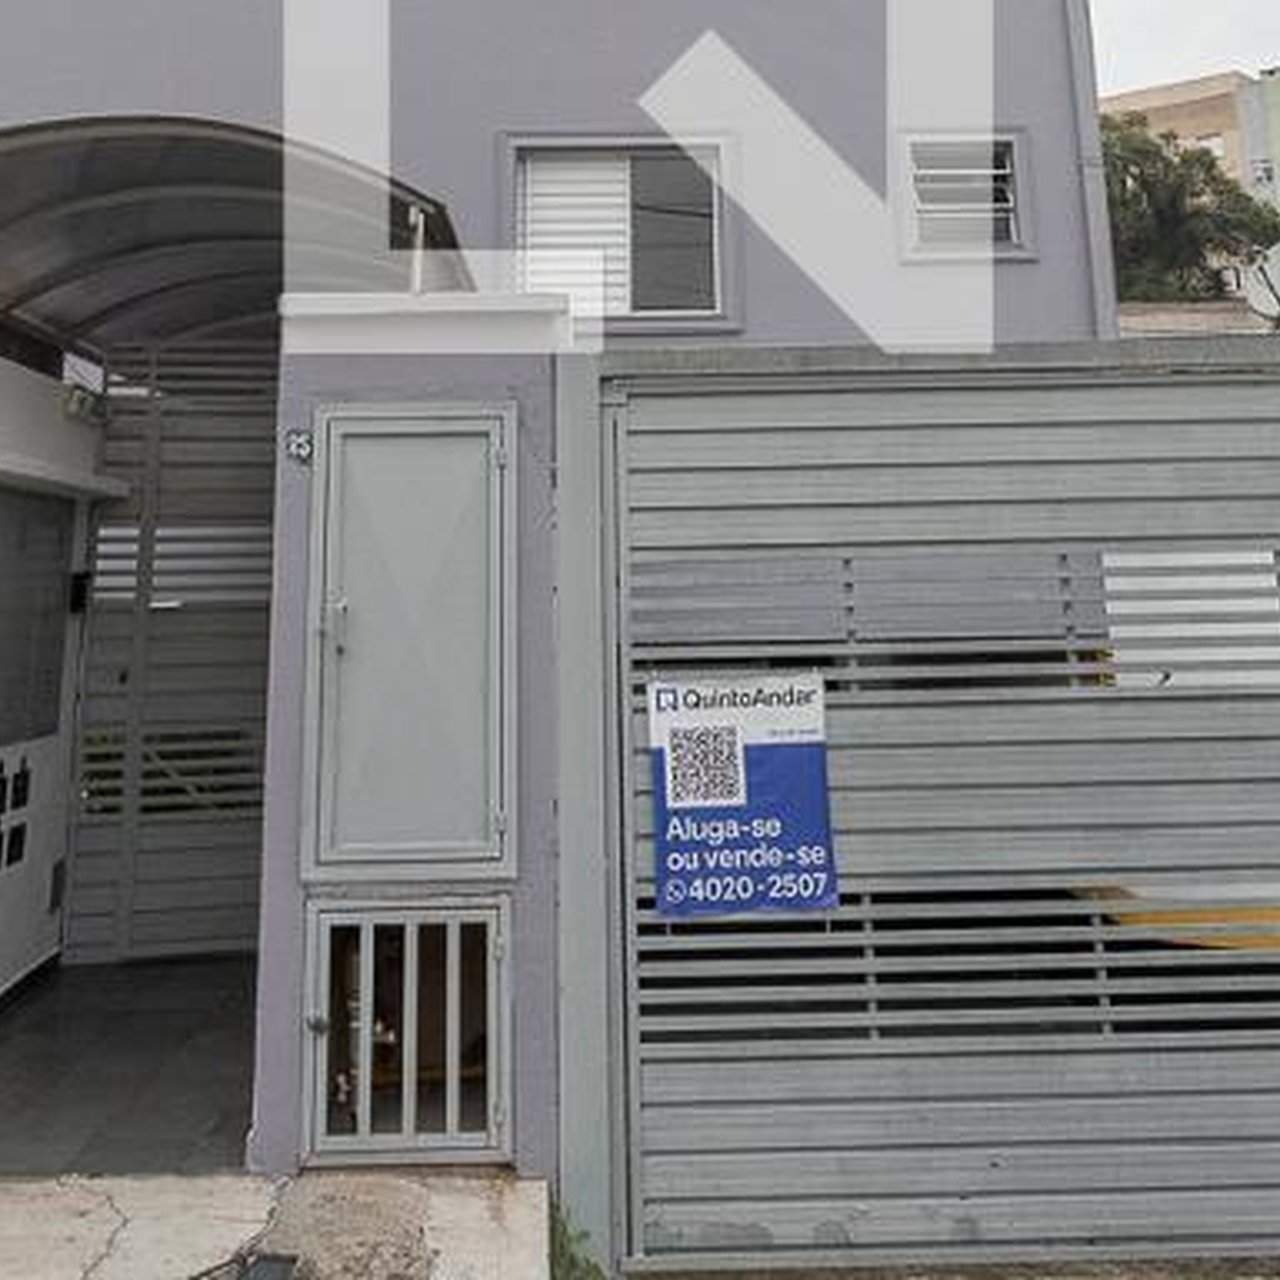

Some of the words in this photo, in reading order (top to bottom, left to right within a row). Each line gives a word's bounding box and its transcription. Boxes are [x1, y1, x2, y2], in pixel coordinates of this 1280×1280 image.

[683, 686, 817, 709] QuintoAndar
[666, 817, 782, 846] Aluga-se
[667, 851, 698, 871] ou
[704, 843, 826, 867] vende-se
[688, 873, 828, 902] 4020-2507
